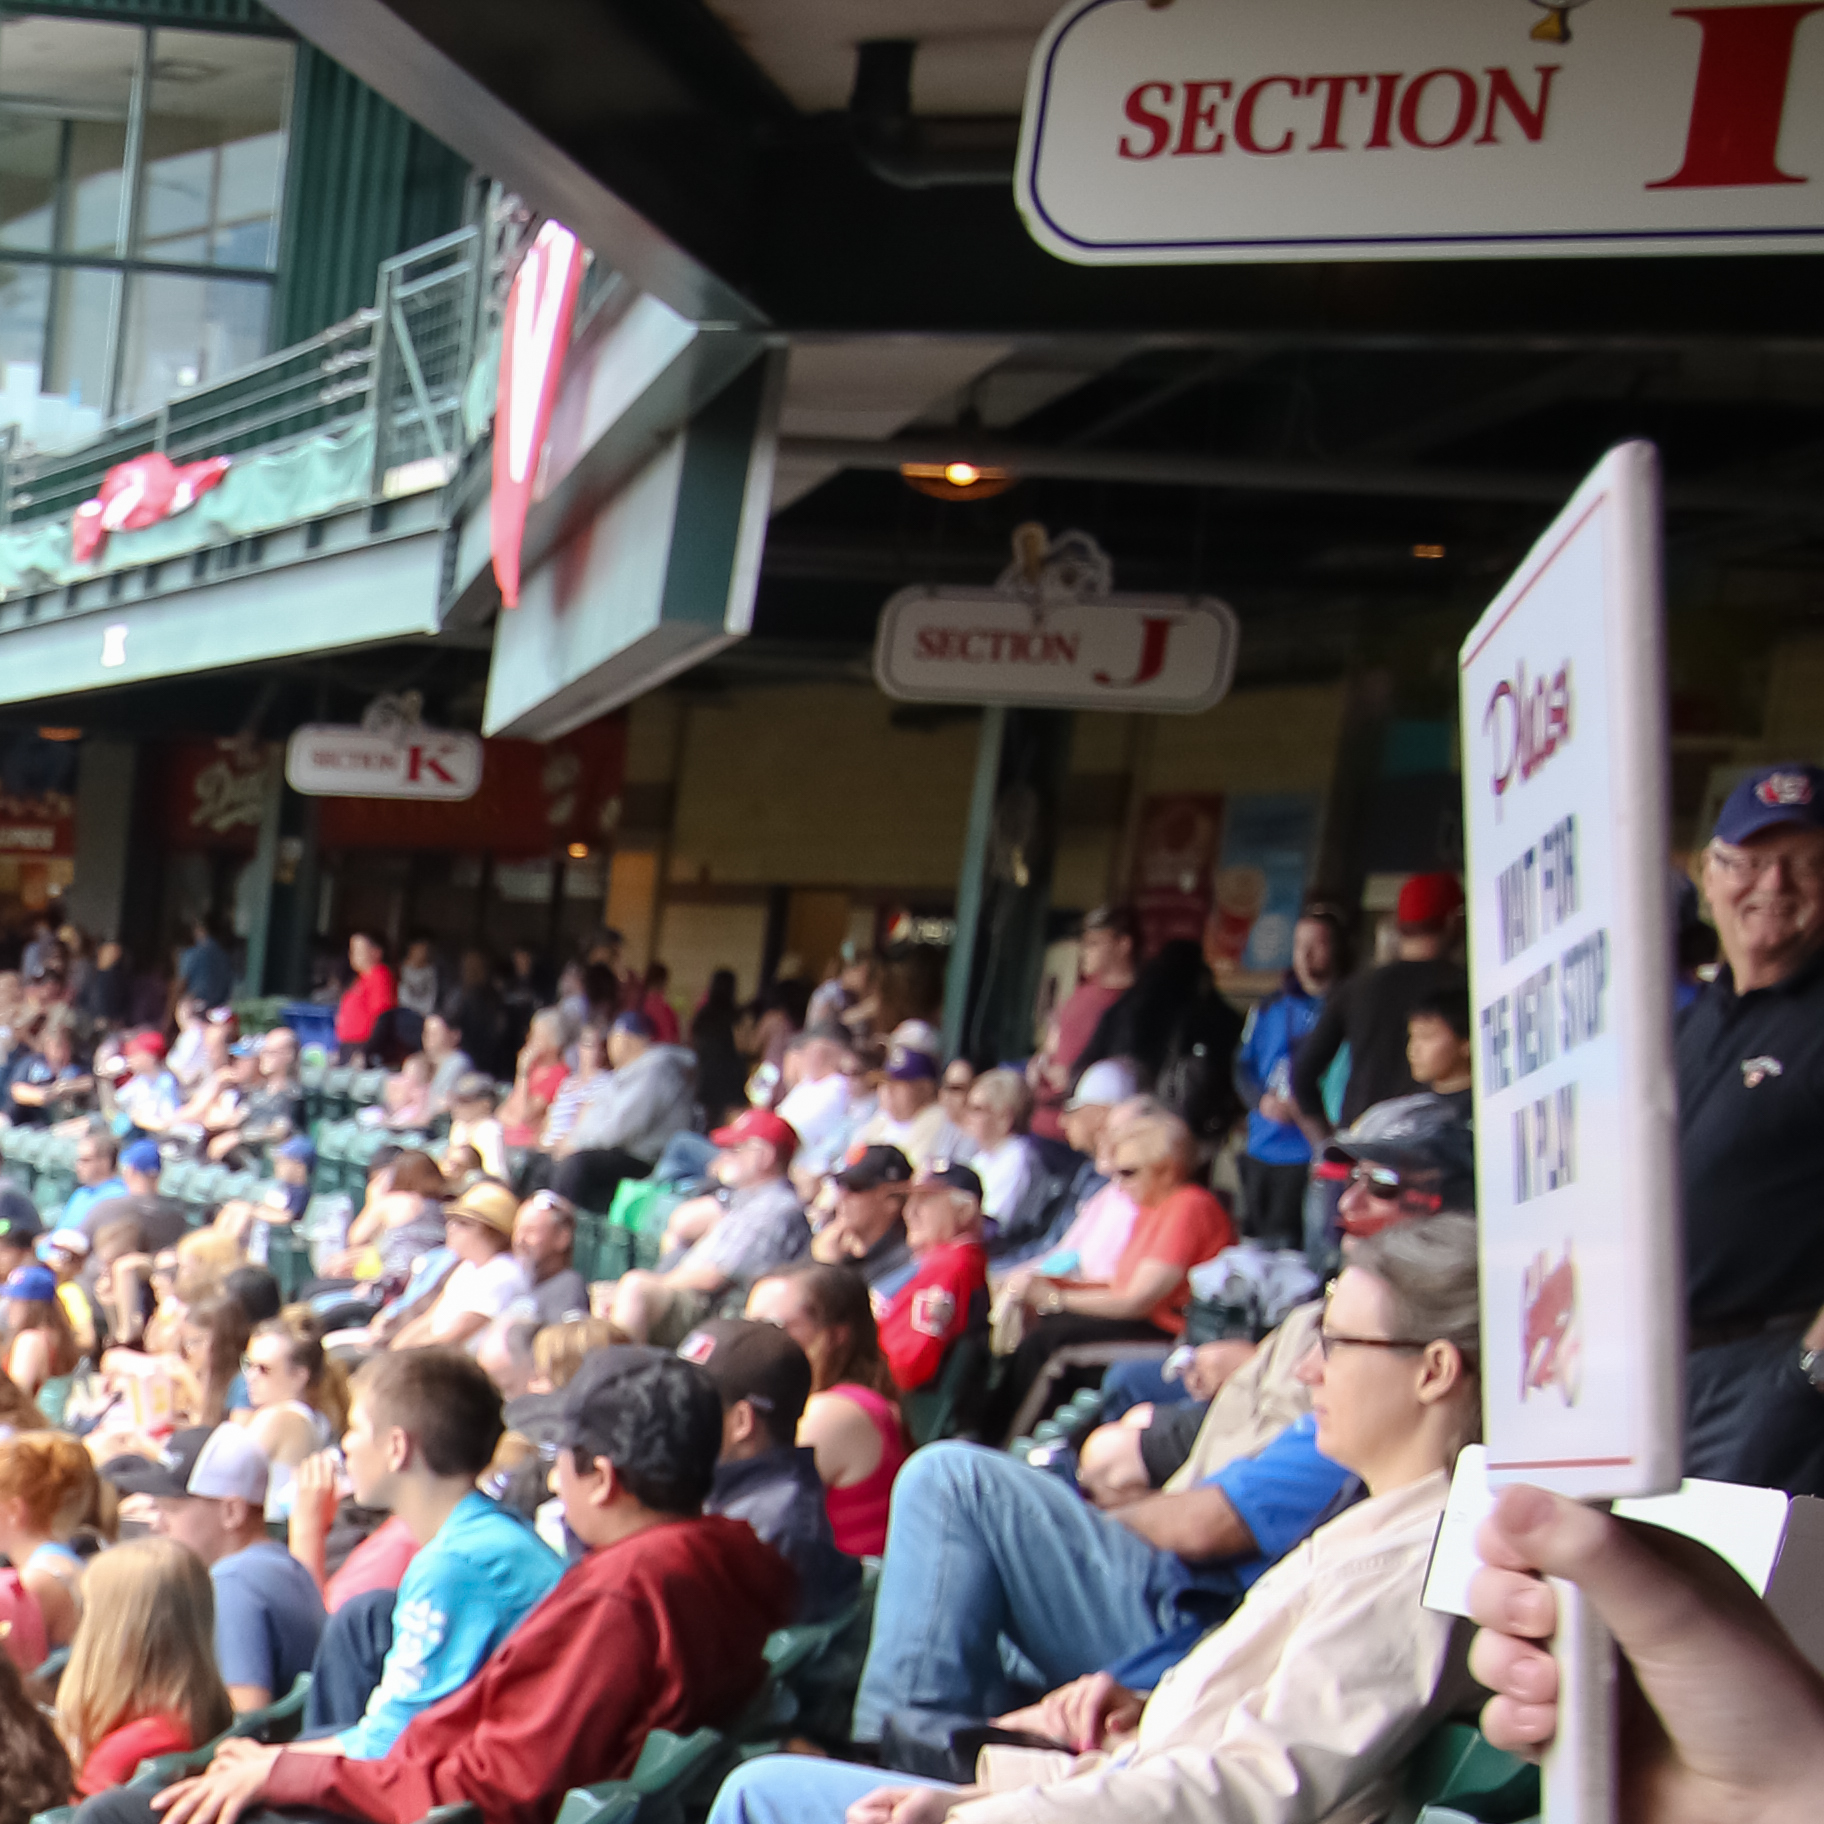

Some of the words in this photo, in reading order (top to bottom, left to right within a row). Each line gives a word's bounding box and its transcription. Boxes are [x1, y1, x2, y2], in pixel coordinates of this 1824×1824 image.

[1117, 65, 1560, 161] SECTION
[1644, 2, 1824, 190] I
[913, 625, 1081, 665] SECTION
[1092, 614, 1181, 690] J
[404, 744, 458, 784] K
